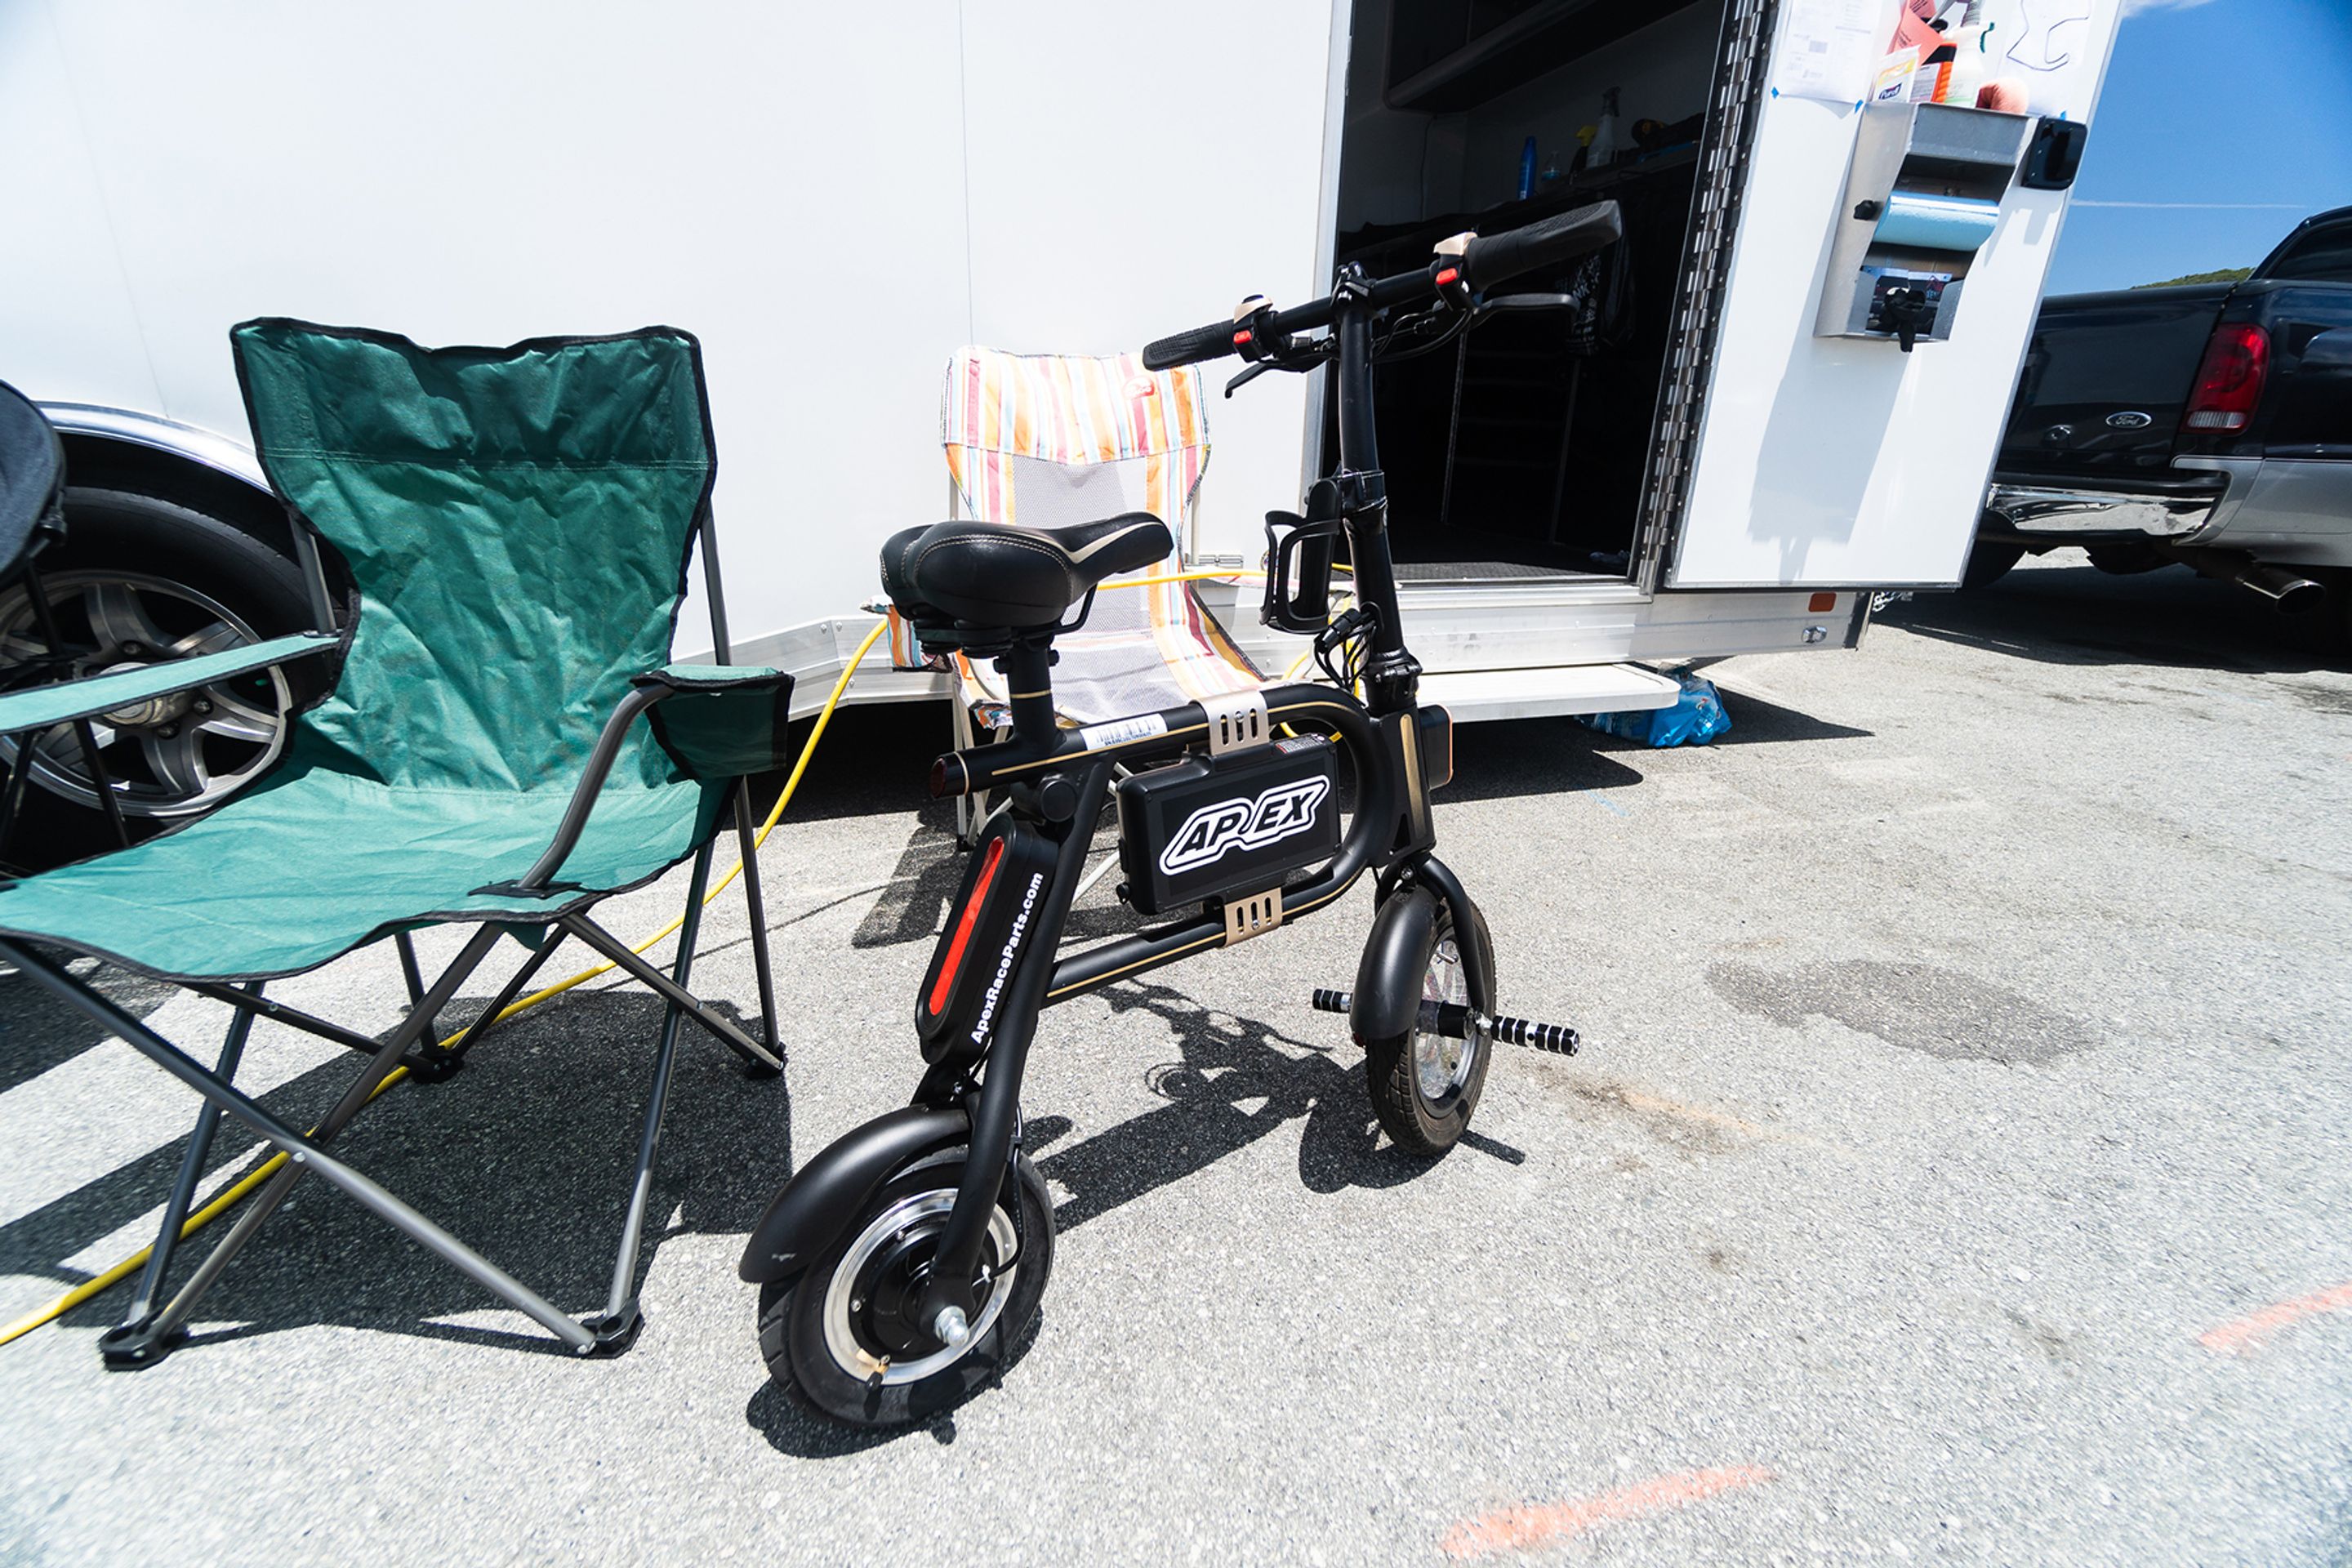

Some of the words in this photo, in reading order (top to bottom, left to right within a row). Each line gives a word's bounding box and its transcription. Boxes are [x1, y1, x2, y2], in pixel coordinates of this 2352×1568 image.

[2115, 415, 2139, 425] Ford
[1174, 789, 1317, 858] APEX
[970, 872, 1044, 1044] ApexRaceParts.com
